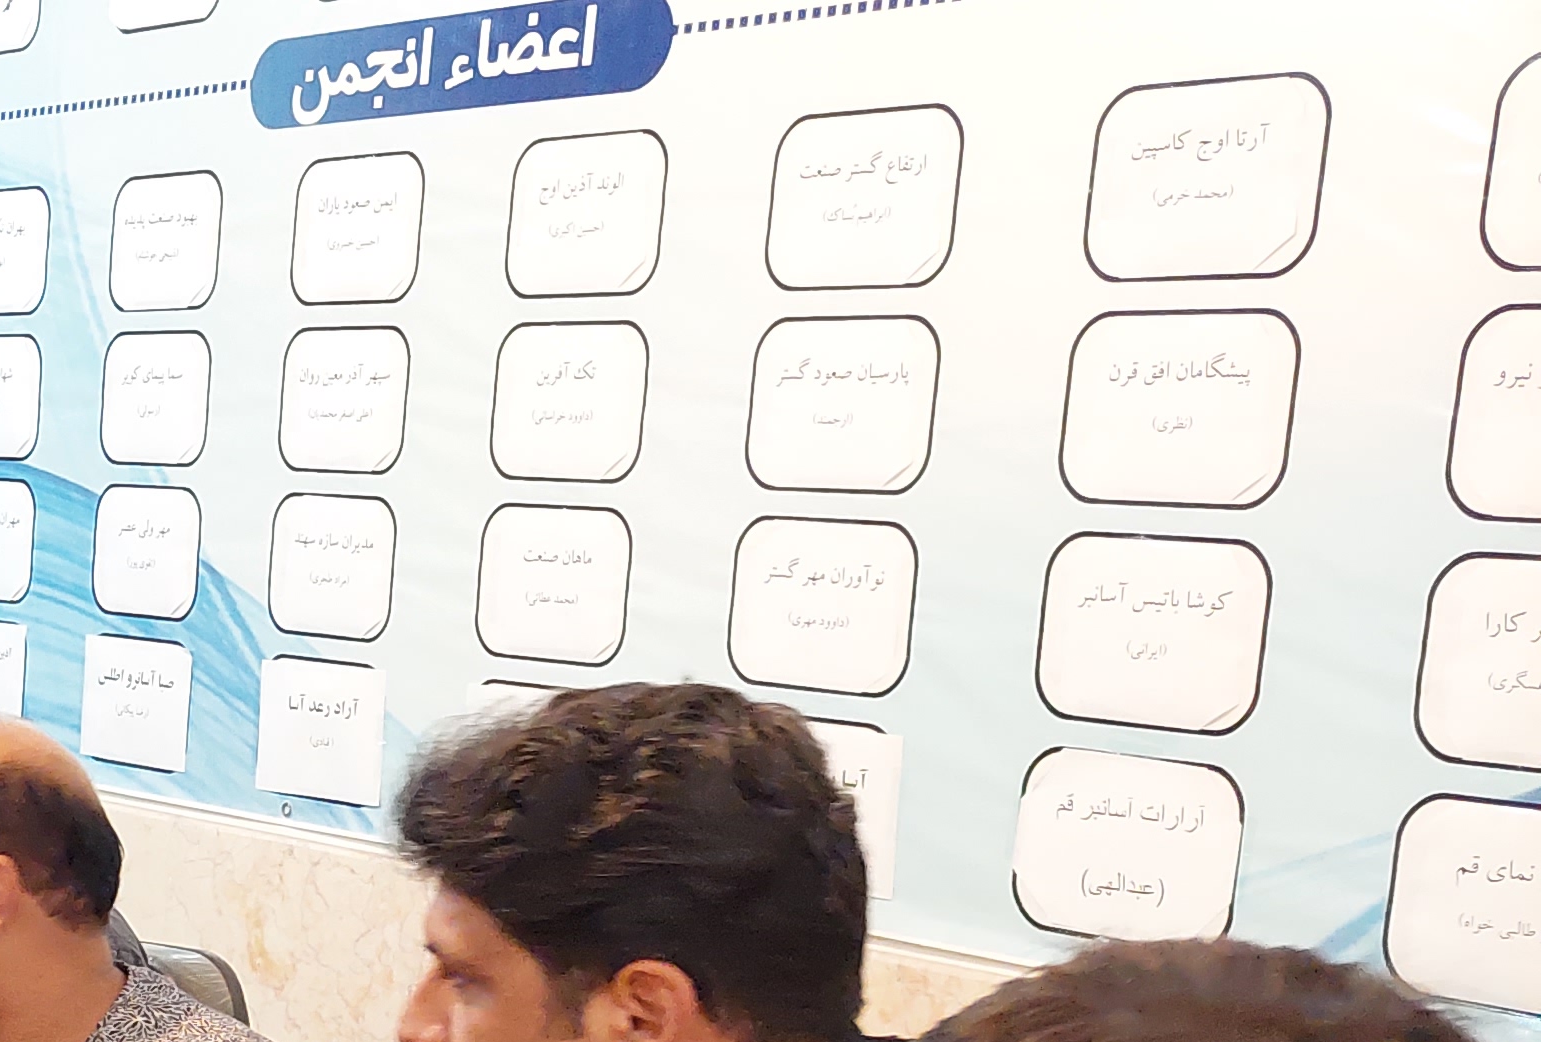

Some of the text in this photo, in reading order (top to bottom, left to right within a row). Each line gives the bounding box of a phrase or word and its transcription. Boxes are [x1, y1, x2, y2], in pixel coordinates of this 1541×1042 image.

[290, 3, 598, 124] اعضاء انجمن
[1131, 122, 1271, 161] آرتا اوج کاسپین
[799, 151, 927, 184] ارتفاع گستر صنعت
[539, 172, 625, 205] الوند آذین اوج
[1153, 185, 1234, 207] (محمد خرمی)
[318, 192, 397, 214] ایمن صعود یاران
[148, 212, 174, 225] صنعت
[366, 371, 391, 386] سپهر
[536, 360, 596, 385] تک آفرین
[775, 358, 909, 387] پارسیان صعود گستر
[1108, 352, 1250, 387] پیشگامان افق قرن
[1493, 362, 1534, 389] نیرو
[568, 410, 593, 423] (داوود
[1152, 415, 1192, 434] (نظری)
[318, 533, 340, 551] سازه
[341, 535, 374, 554] مدیران
[523, 549, 592, 566] ماهان صنعت
[764, 557, 800, 584] گستر
[802, 570, 825, 586] مهر
[553, 593, 579, 605] (محمد
[1077, 582, 1129, 609] آسانبر
[1186, 590, 1233, 617] کوشا
[788, 612, 850, 630] (داوود مهری)
[1486, 611, 1527, 638] کارا
[1126, 640, 1167, 661] (ایرانی)
[288, 694, 360, 719] آراد رعد آسا
[1056, 793, 1205, 833] آرارات آسانبر قم
[1456, 855, 1535, 886] نمای قم
